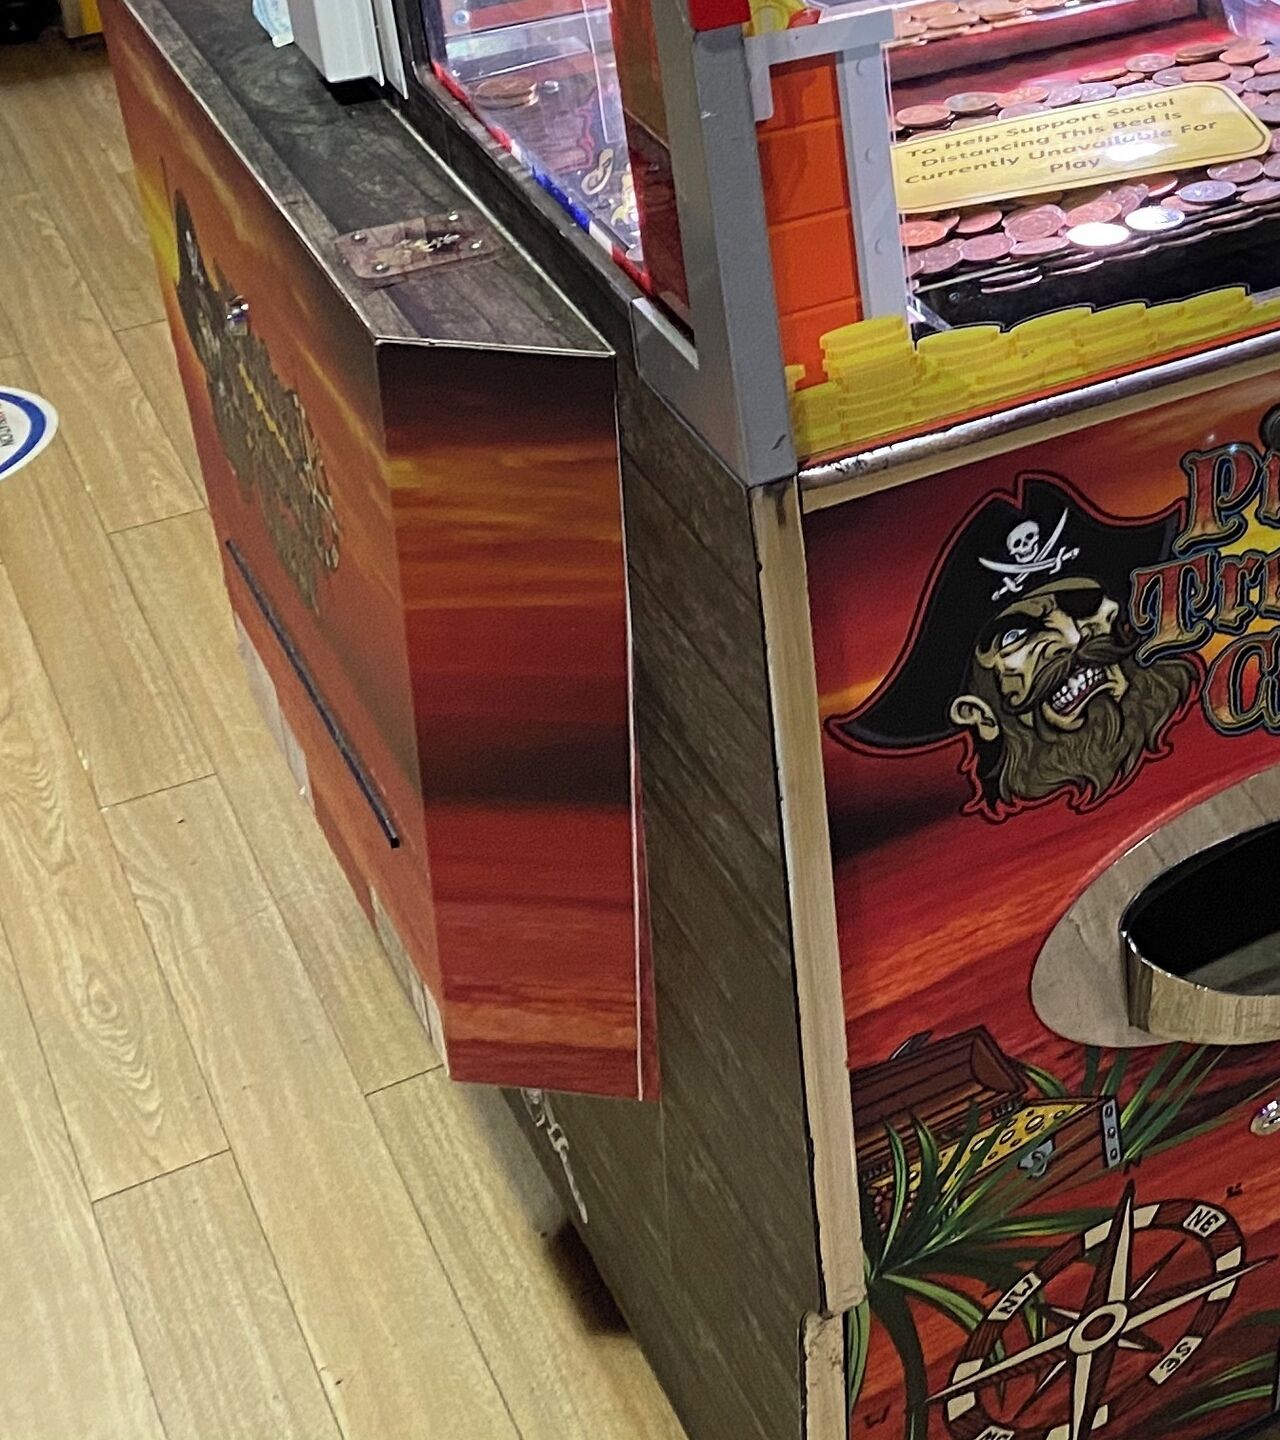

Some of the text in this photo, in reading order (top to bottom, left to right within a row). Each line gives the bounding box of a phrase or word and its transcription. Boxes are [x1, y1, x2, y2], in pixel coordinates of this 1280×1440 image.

[905, 119, 1218, 185] Currently Unavailable For
[906, 97, 1174, 158] To Help Support Social
[920, 110, 1182, 169] Distancing This Bed Is
[1049, 158, 1100, 175] Play
